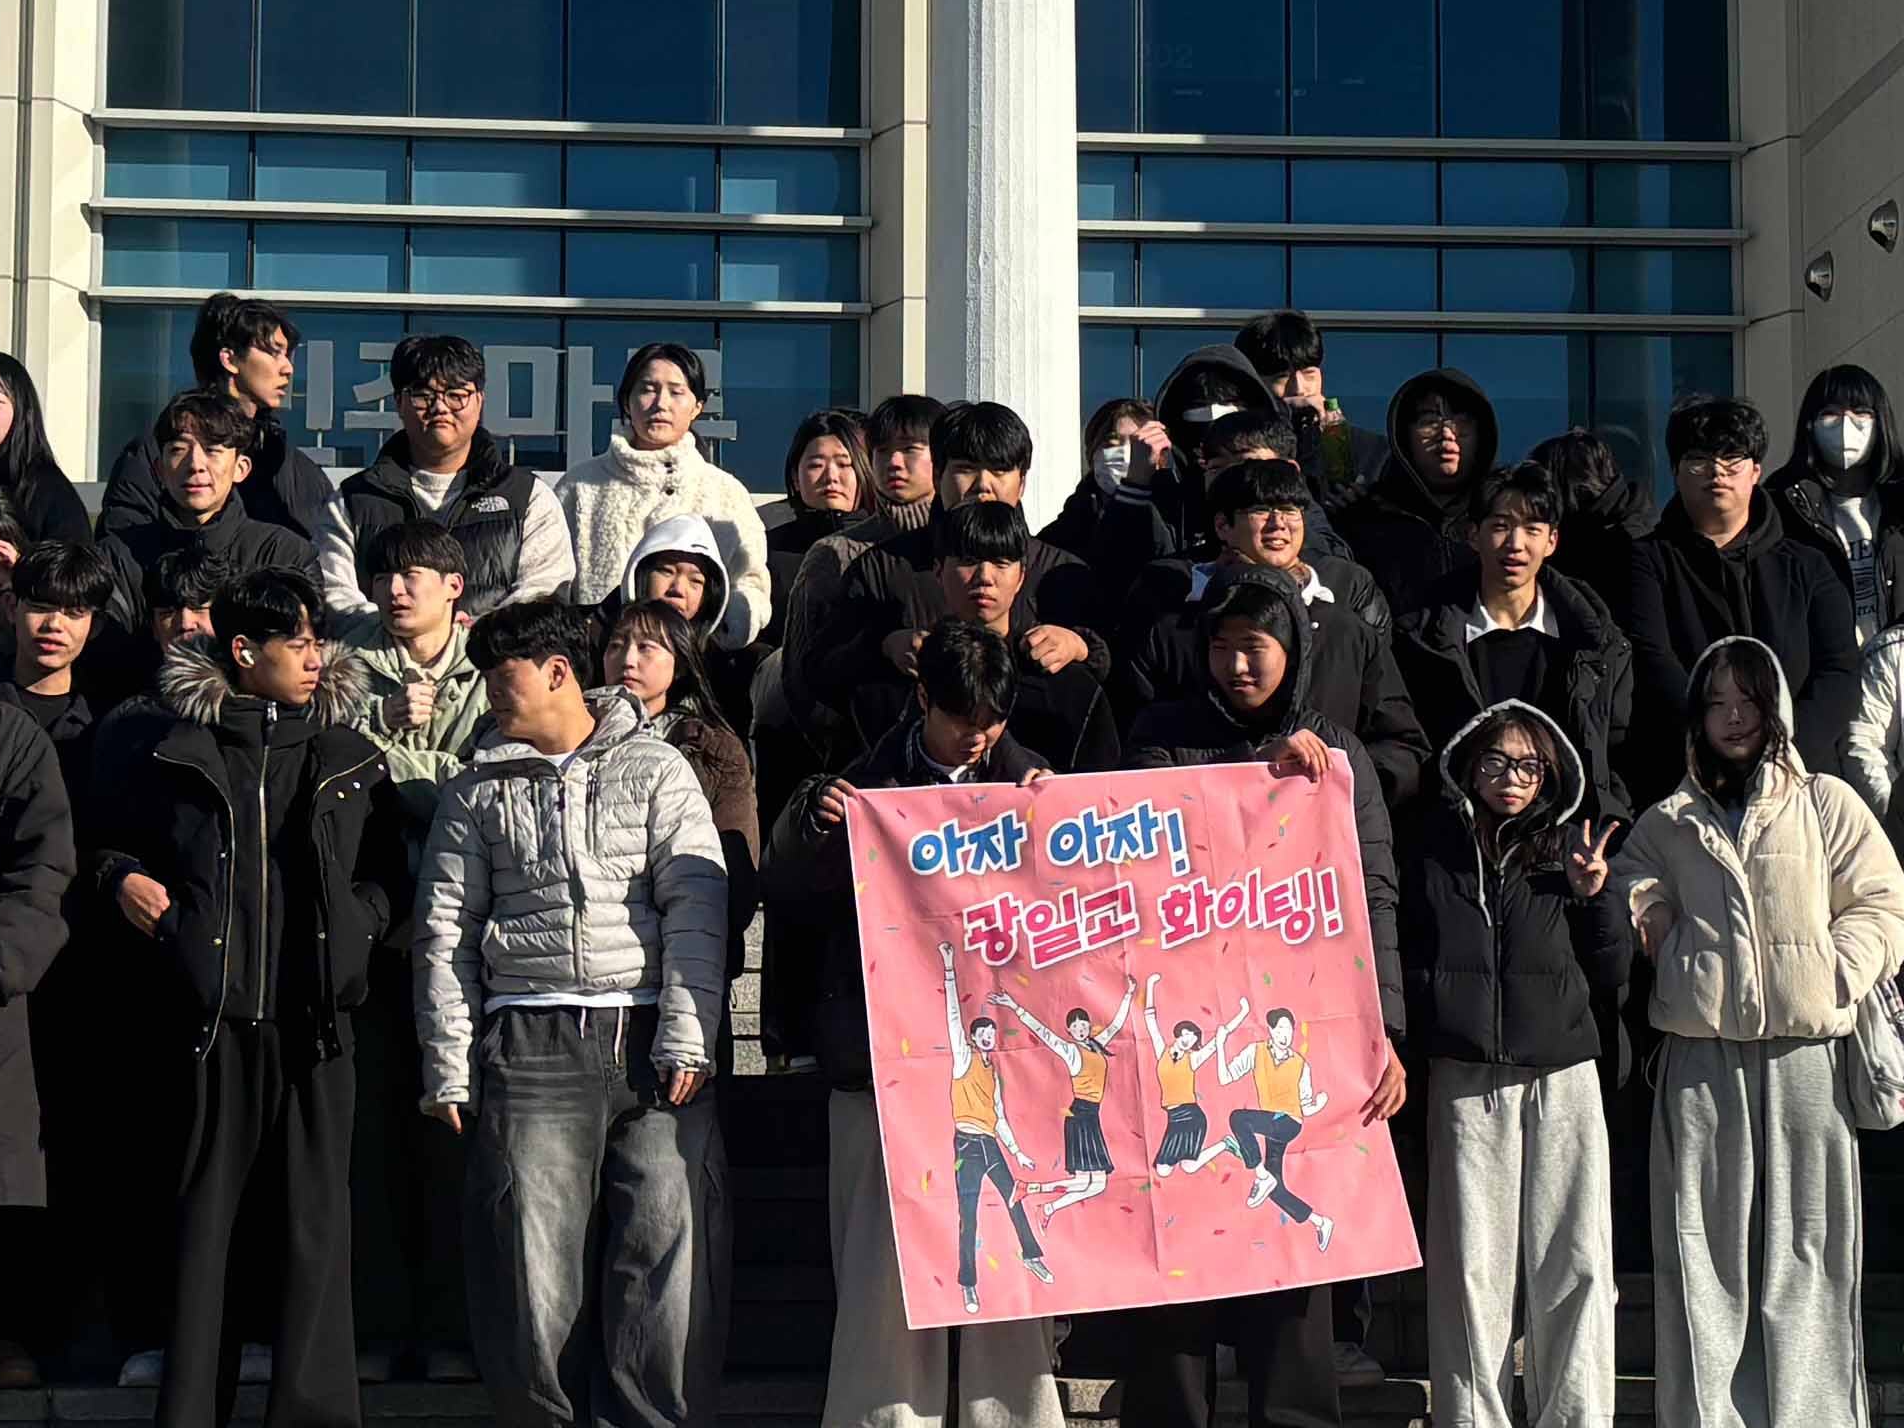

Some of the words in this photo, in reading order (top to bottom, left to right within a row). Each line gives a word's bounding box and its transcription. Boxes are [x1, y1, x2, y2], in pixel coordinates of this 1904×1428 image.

[910, 808, 1029, 876] 아자
[1046, 799, 1190, 876] 아자!
[963, 883, 1140, 970] 광일고
[1159, 867, 1344, 949] 화이팅!
